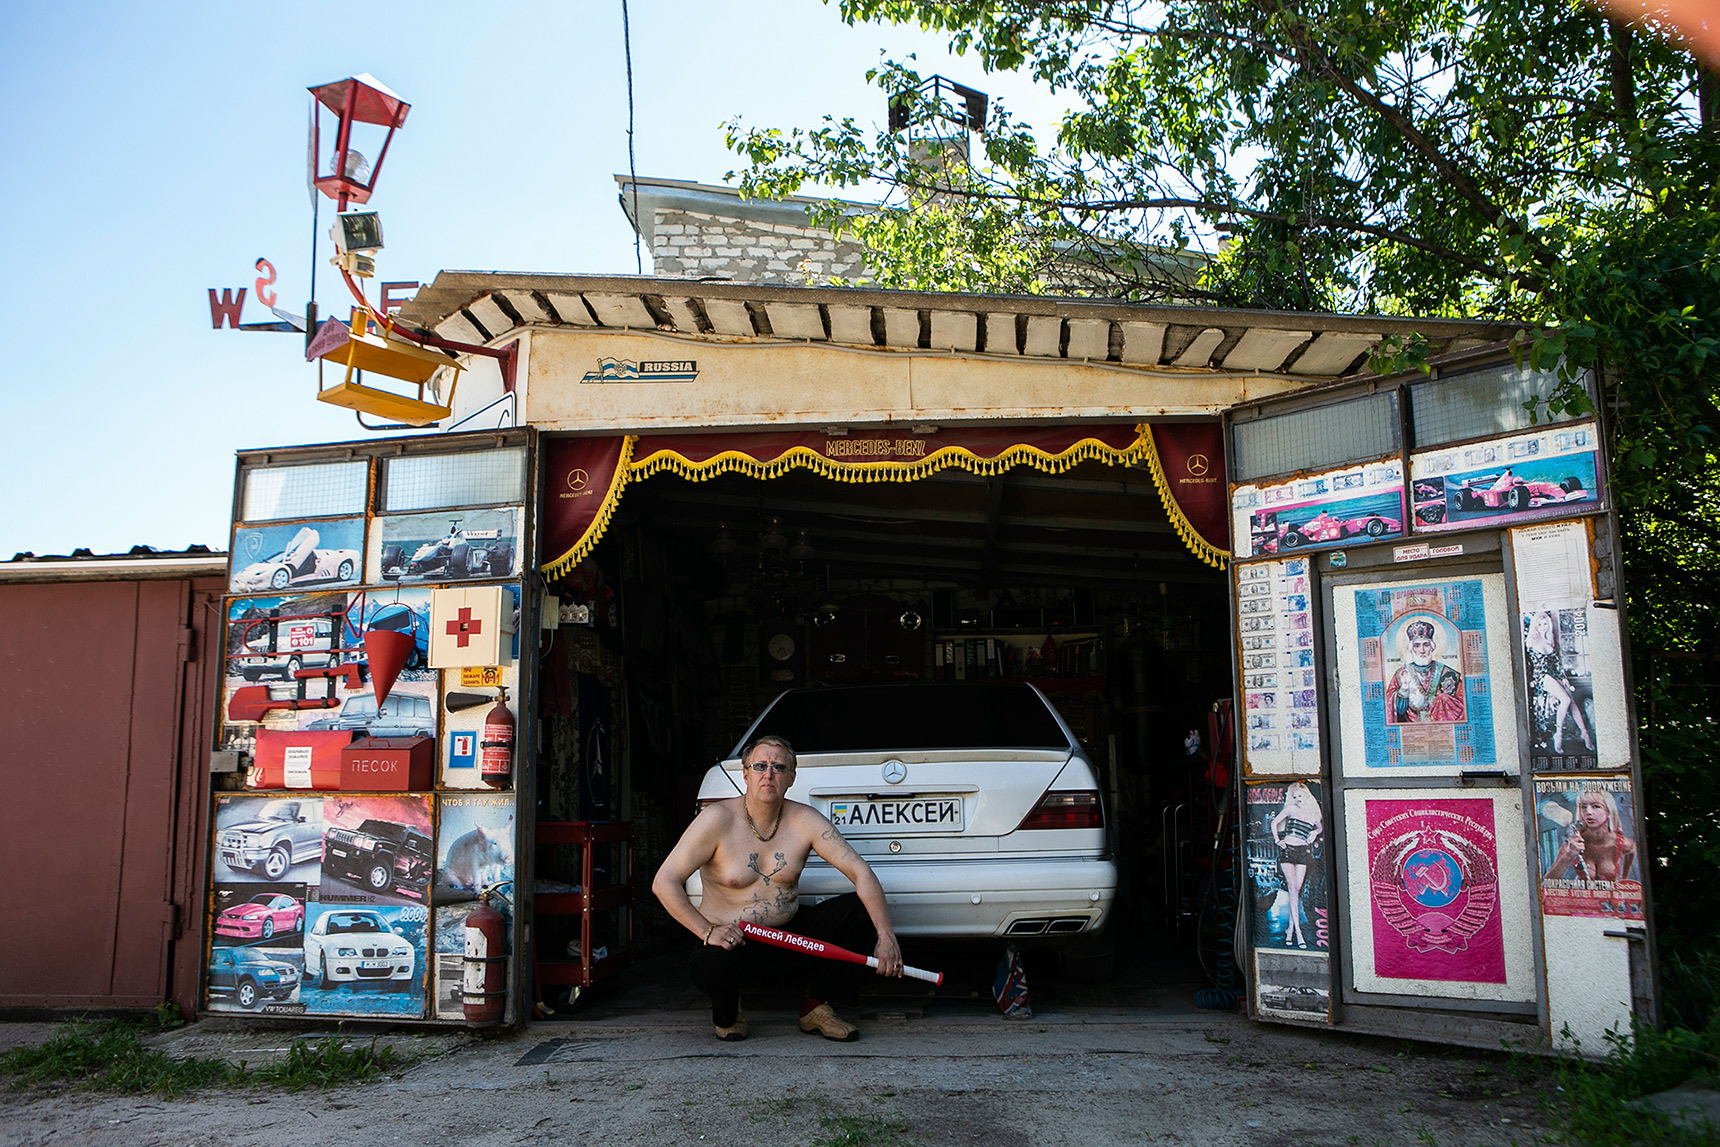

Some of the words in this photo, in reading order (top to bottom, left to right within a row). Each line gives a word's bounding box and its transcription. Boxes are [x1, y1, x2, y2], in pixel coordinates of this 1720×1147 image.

[208, 287, 248, 330] W
[643, 361, 693, 372] RUSSIA
[825, 439, 926, 457] MERCEDES-BENZ
[1573, 610, 1586, 638] 2004
[298, 636, 314, 646] 101
[351, 759, 399, 773] ПЕСОК
[1536, 780, 1568, 793] ВОЗЬМИ
[1569, 781, 1580, 792] НА
[1582, 780, 1632, 793] ВООРУЖЕНИЕ
[441, 798, 464, 807] ЧТОБ
[465, 799, 471, 807] Я
[473, 799, 489, 807] ТАК
[849, 801, 955, 825] АЛЕКСЕЙ
[1380, 811, 1410, 829] Советских
[1408, 808, 1465, 822] Социалистических
[834, 816, 847, 825] 21
[320, 894, 367, 902] HUMMER
[367, 895, 376, 903] H2
[744, 923, 783, 942] Алексей
[784, 934, 825, 952] Лебедев
[276, 1005, 304, 1014] TOUAREG
